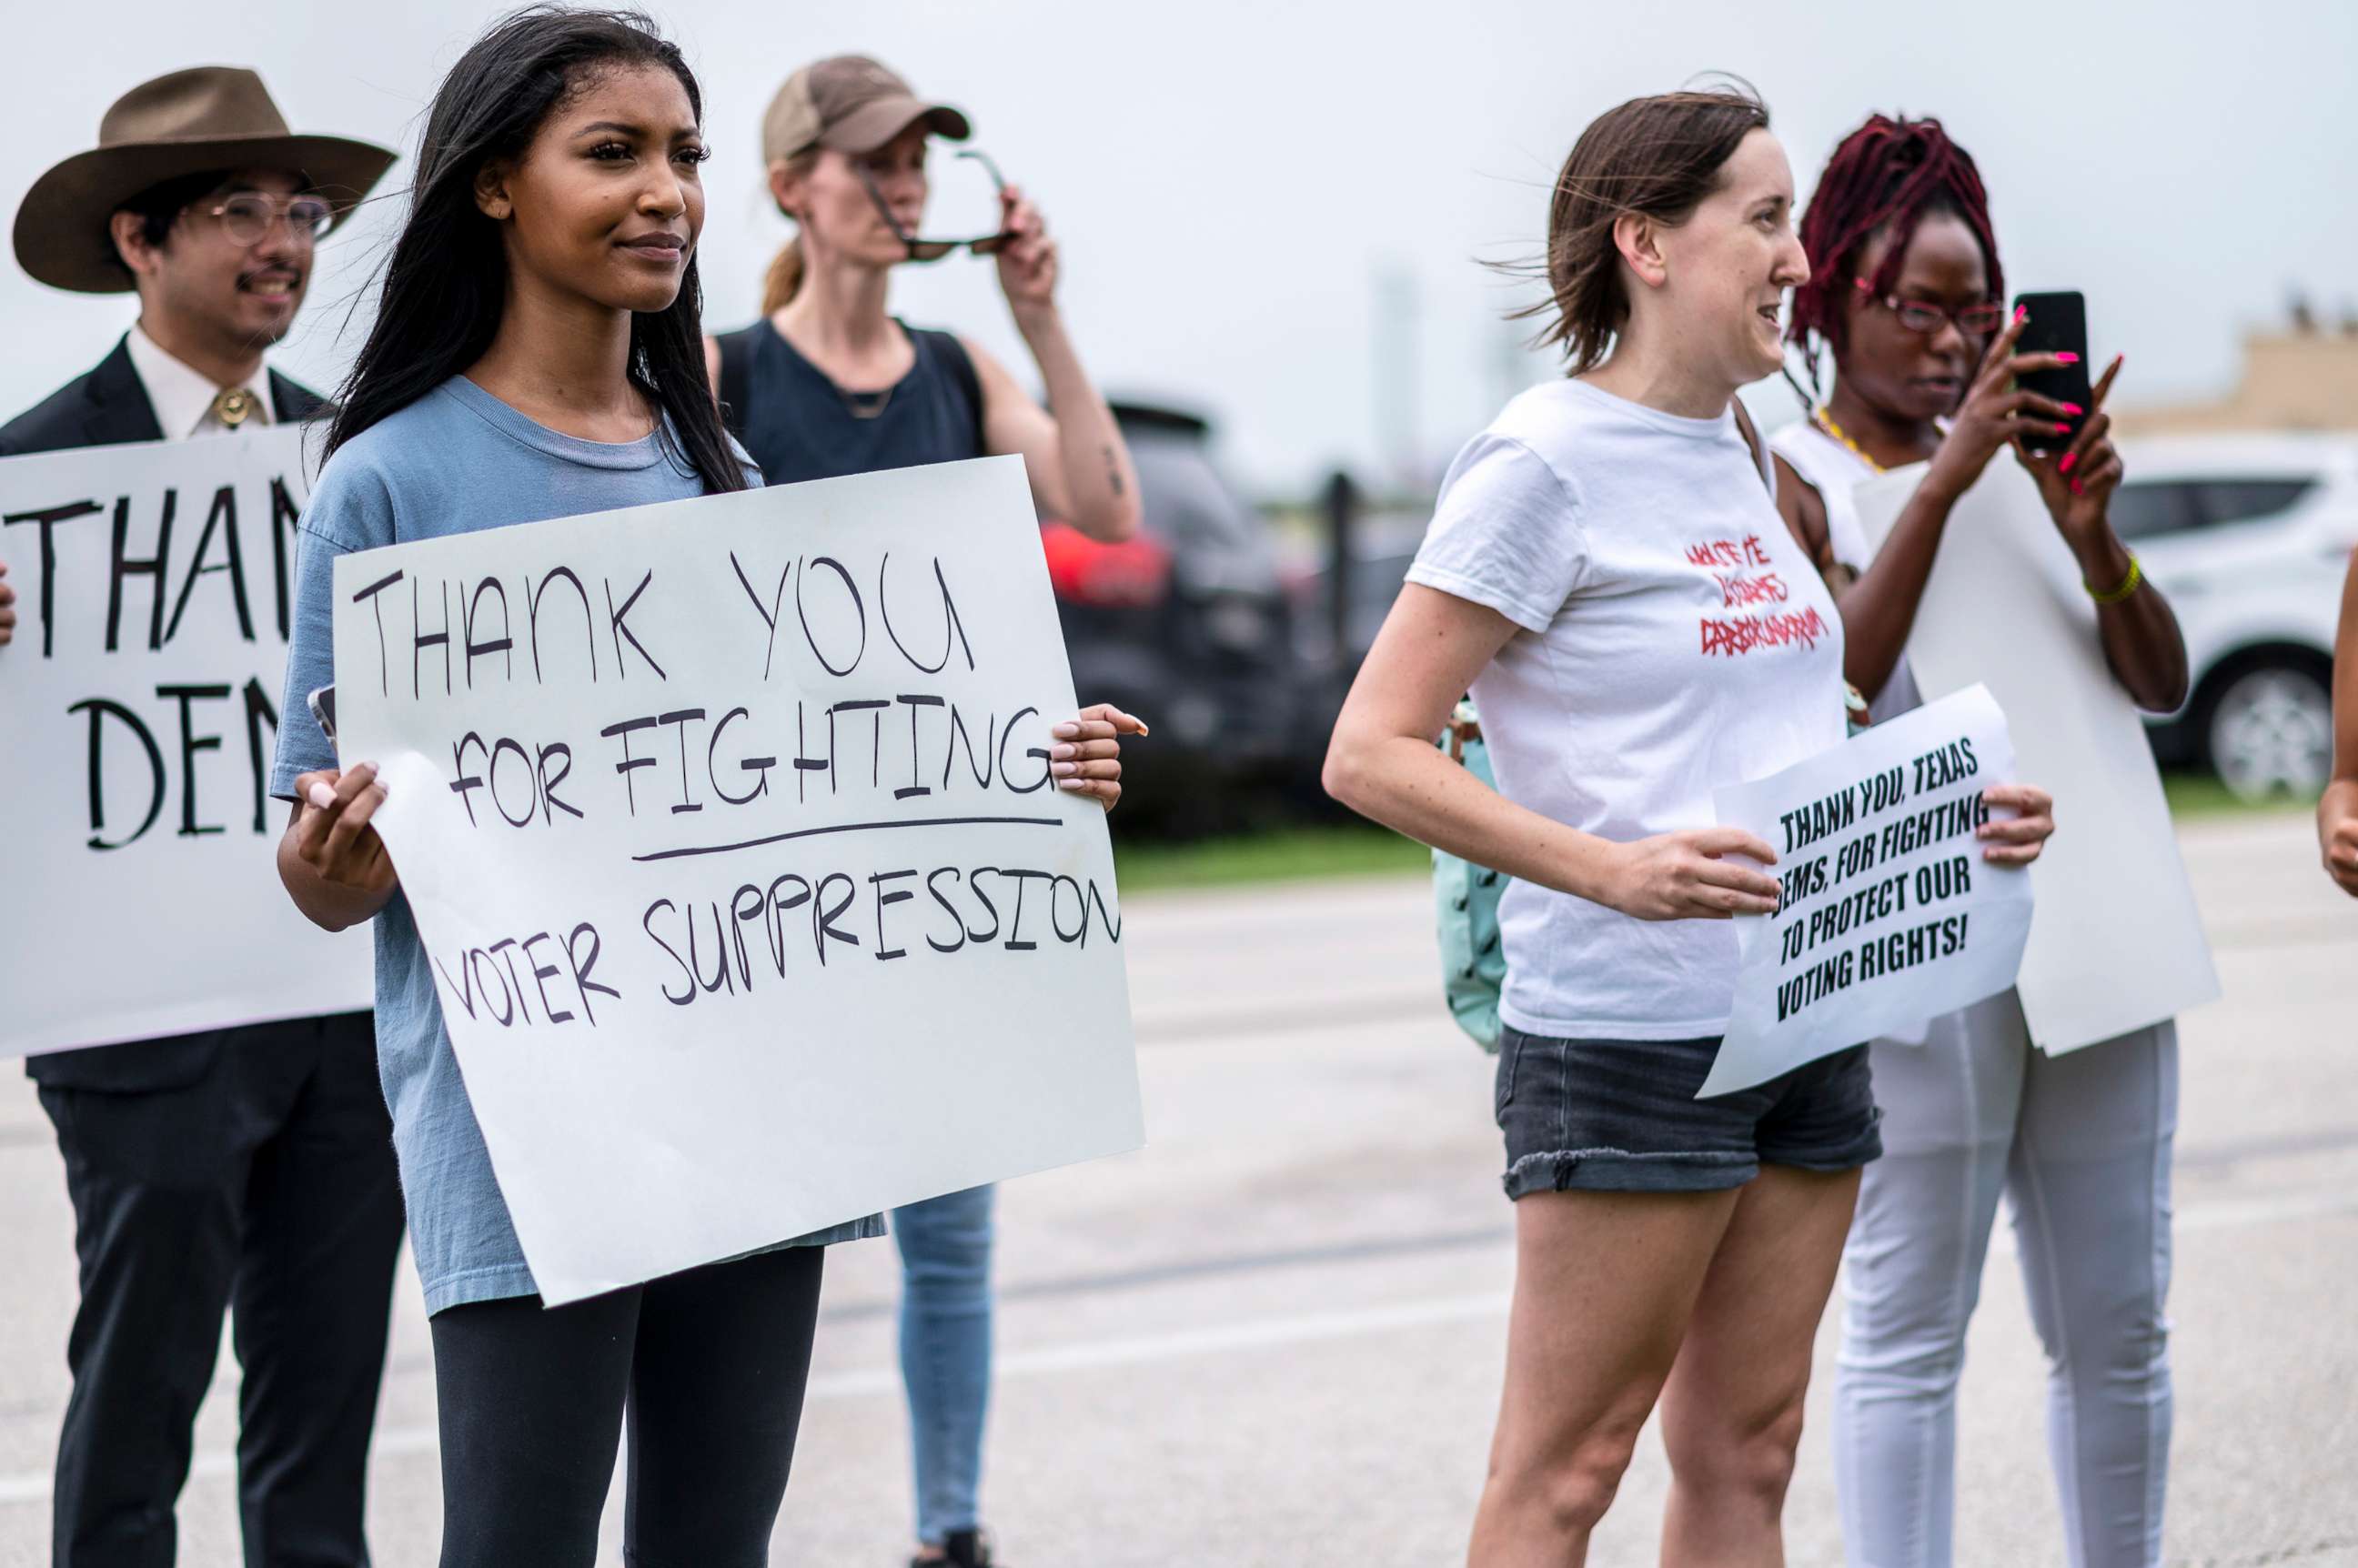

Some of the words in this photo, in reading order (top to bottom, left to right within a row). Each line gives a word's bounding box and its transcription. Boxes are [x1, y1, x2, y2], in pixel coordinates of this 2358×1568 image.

[353, 566, 666, 700] THANK
[731, 550, 974, 680] YOU
[600, 694, 1054, 816] FIGHTING
[1780, 786, 1855, 855] THANK
[1859, 765, 1906, 818] YOU,
[1912, 736, 1979, 795] TEXAS
[1834, 832, 1877, 885] FOR
[1879, 790, 1990, 863] FIGHTING
[435, 922, 620, 1027] VOTER
[643, 867, 1122, 1006] SUPPRESSION
[1778, 950, 1853, 1023] VOTING
[1859, 913, 1969, 982] RIGHTS!
[1780, 920, 1803, 966] TO
[1809, 872, 1909, 950] PROTECT
[1915, 855, 1971, 906] OUR
